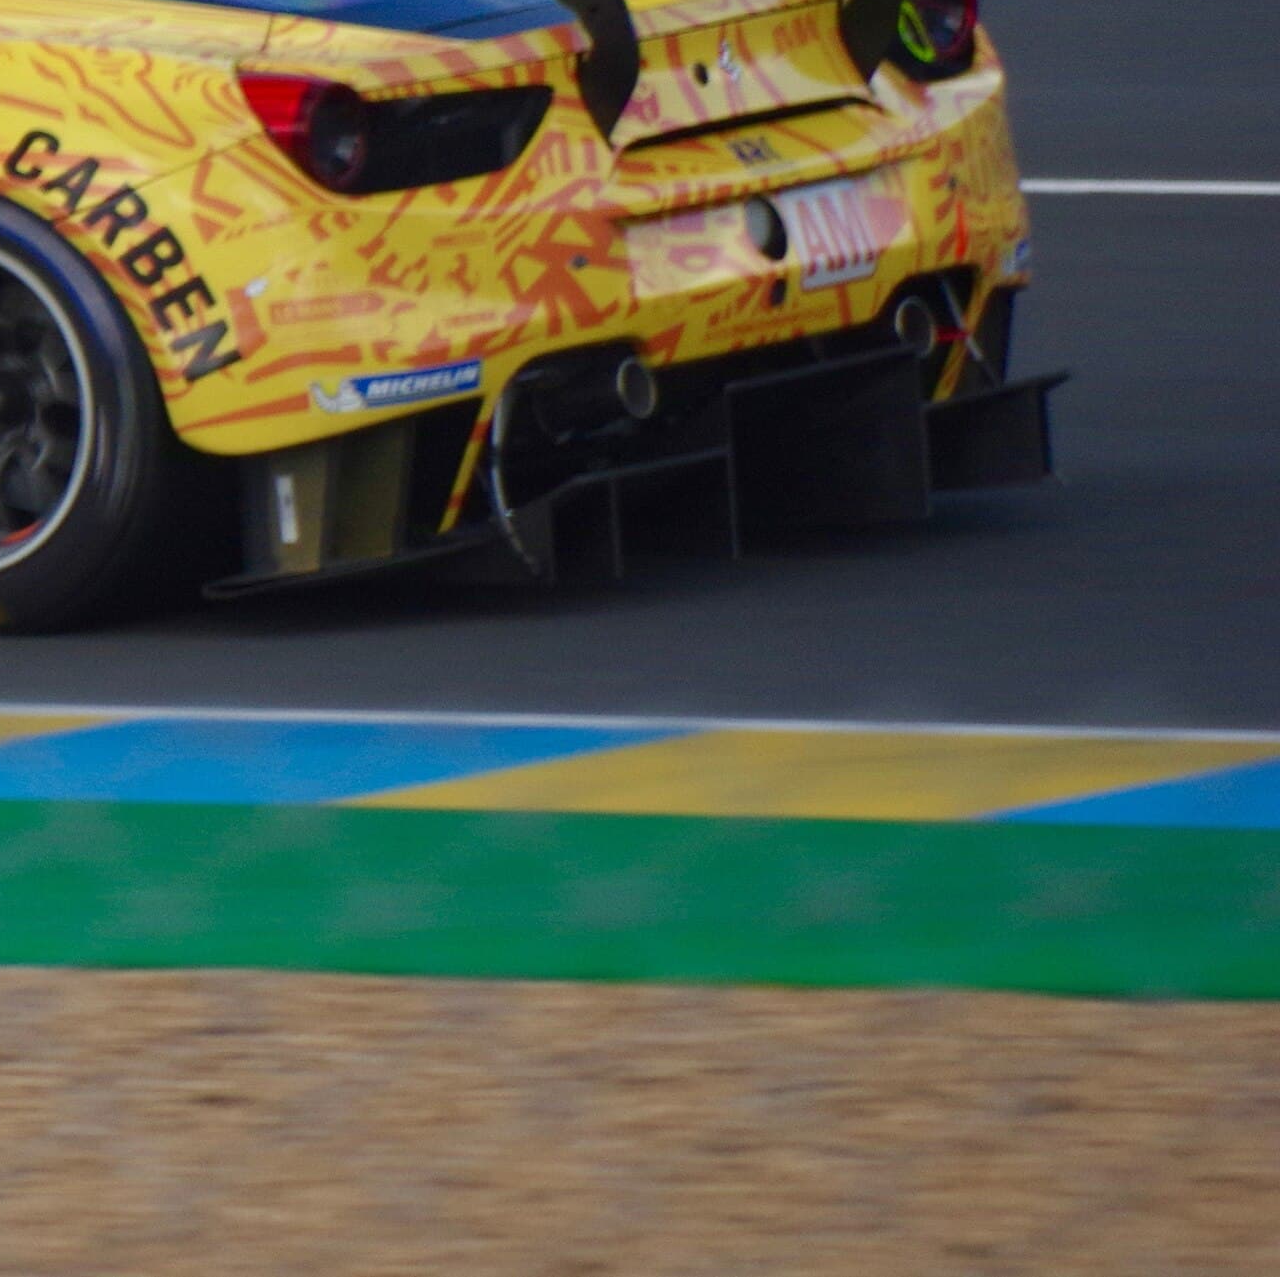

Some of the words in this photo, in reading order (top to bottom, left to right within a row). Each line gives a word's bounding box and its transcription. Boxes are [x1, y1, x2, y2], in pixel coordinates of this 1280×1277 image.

[3, 130, 242, 384] CARBEN
[795, 186, 878, 276] AM
[365, 365, 478, 399] MICHELIN
